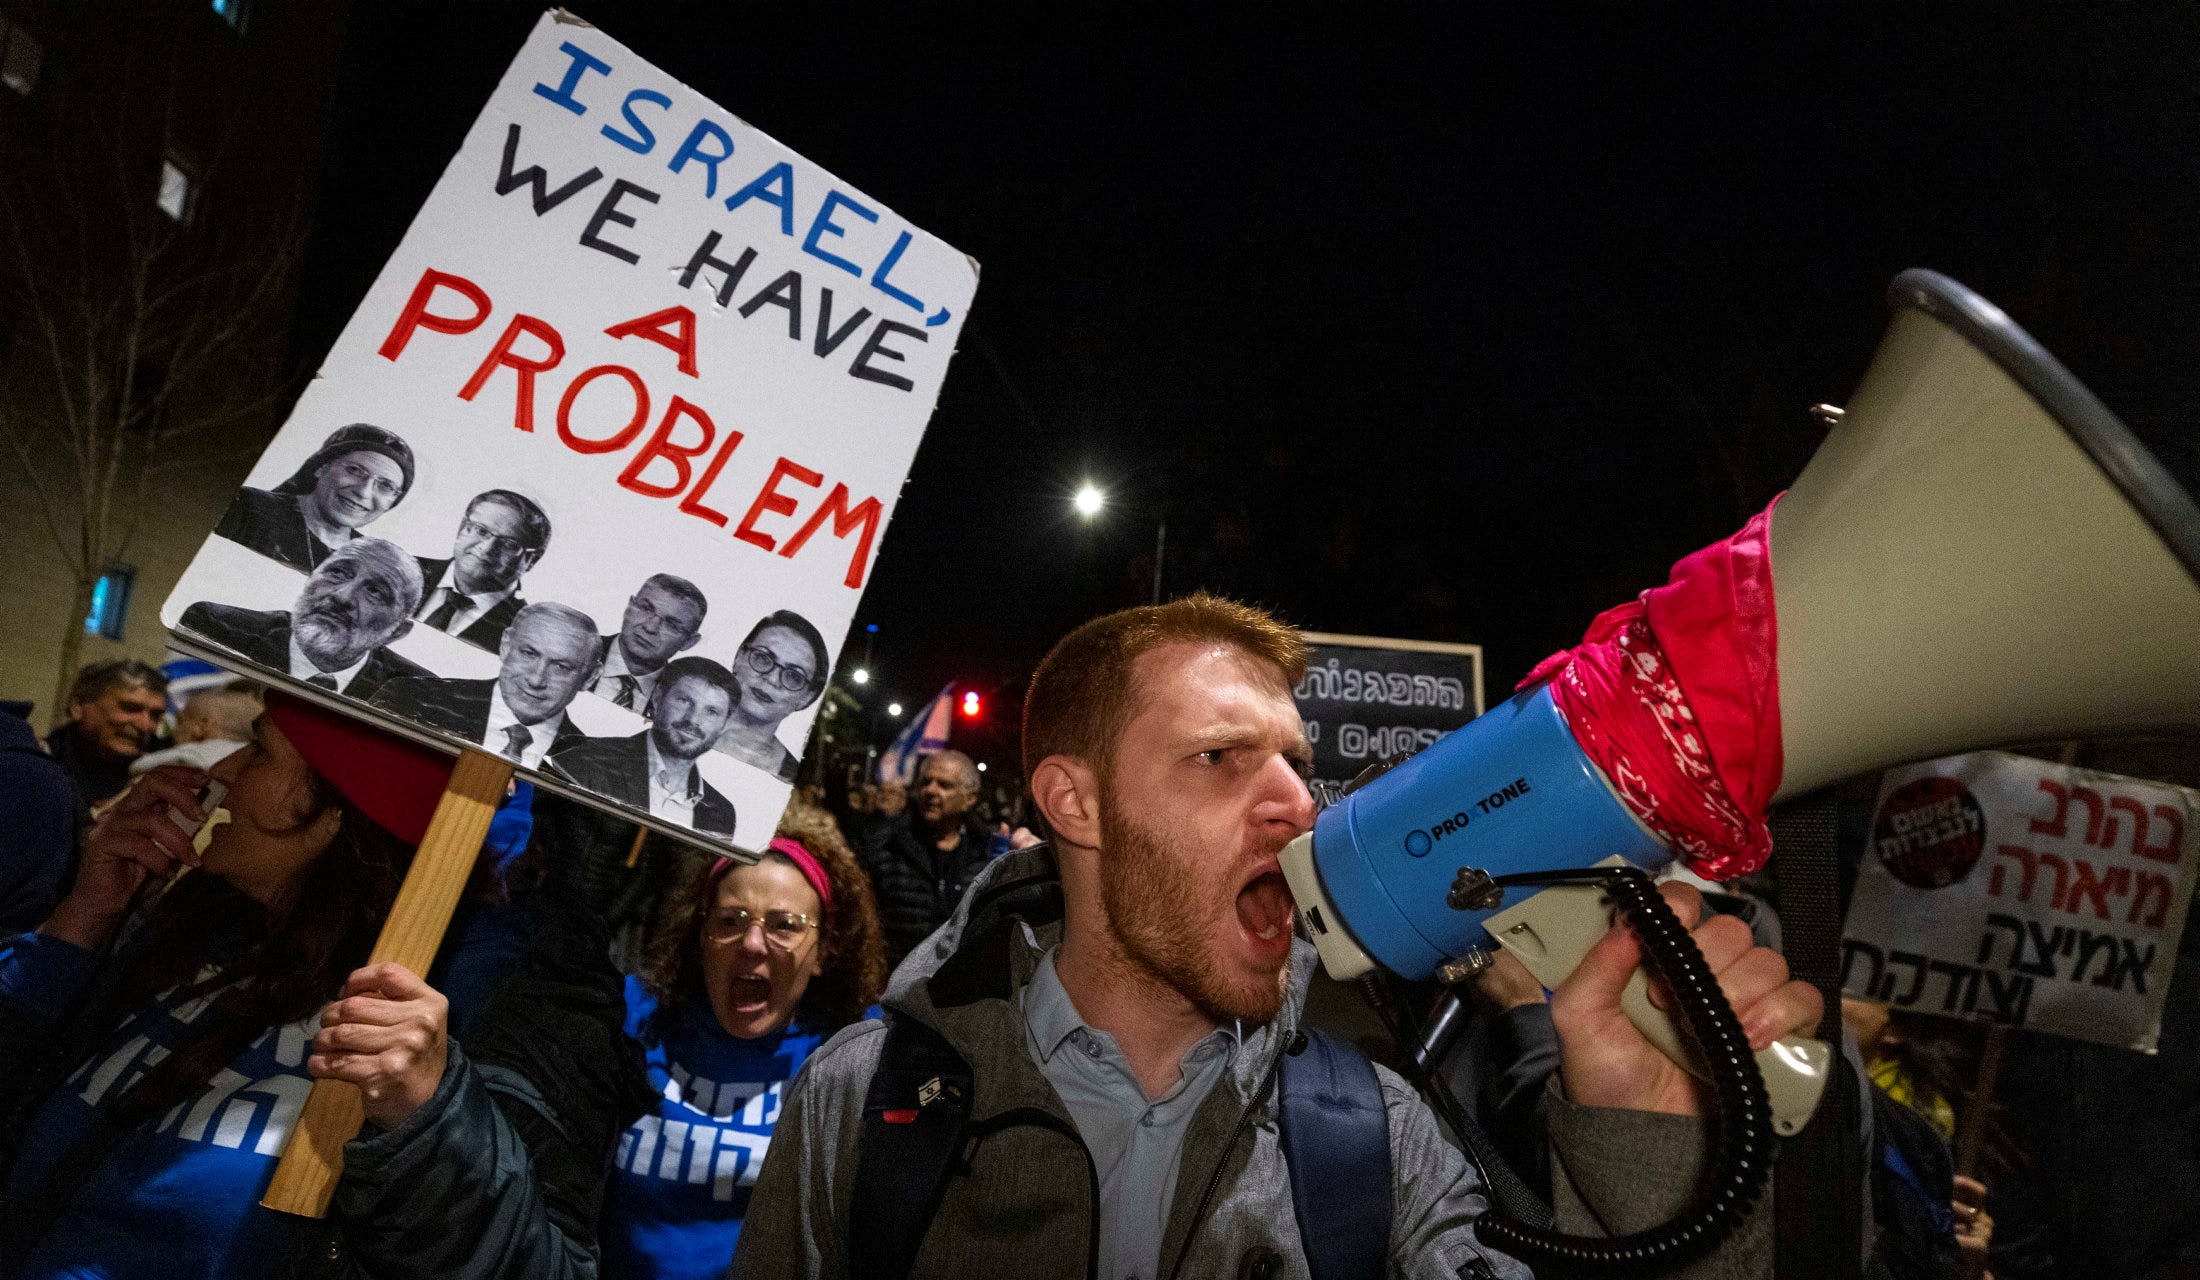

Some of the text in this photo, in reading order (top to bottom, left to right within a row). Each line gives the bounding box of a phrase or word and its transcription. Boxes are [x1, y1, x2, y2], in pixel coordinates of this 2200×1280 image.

[534, 41, 952, 327] ISRAEL,
[494, 123, 929, 392] WE HAVE
[604, 305, 699, 379] A
[378, 267, 883, 590] PROBLEM
[2029, 778, 2184, 864] בהרב
[1987, 844, 2173, 929] מיארה
[1976, 912, 2156, 994] אמיצה
